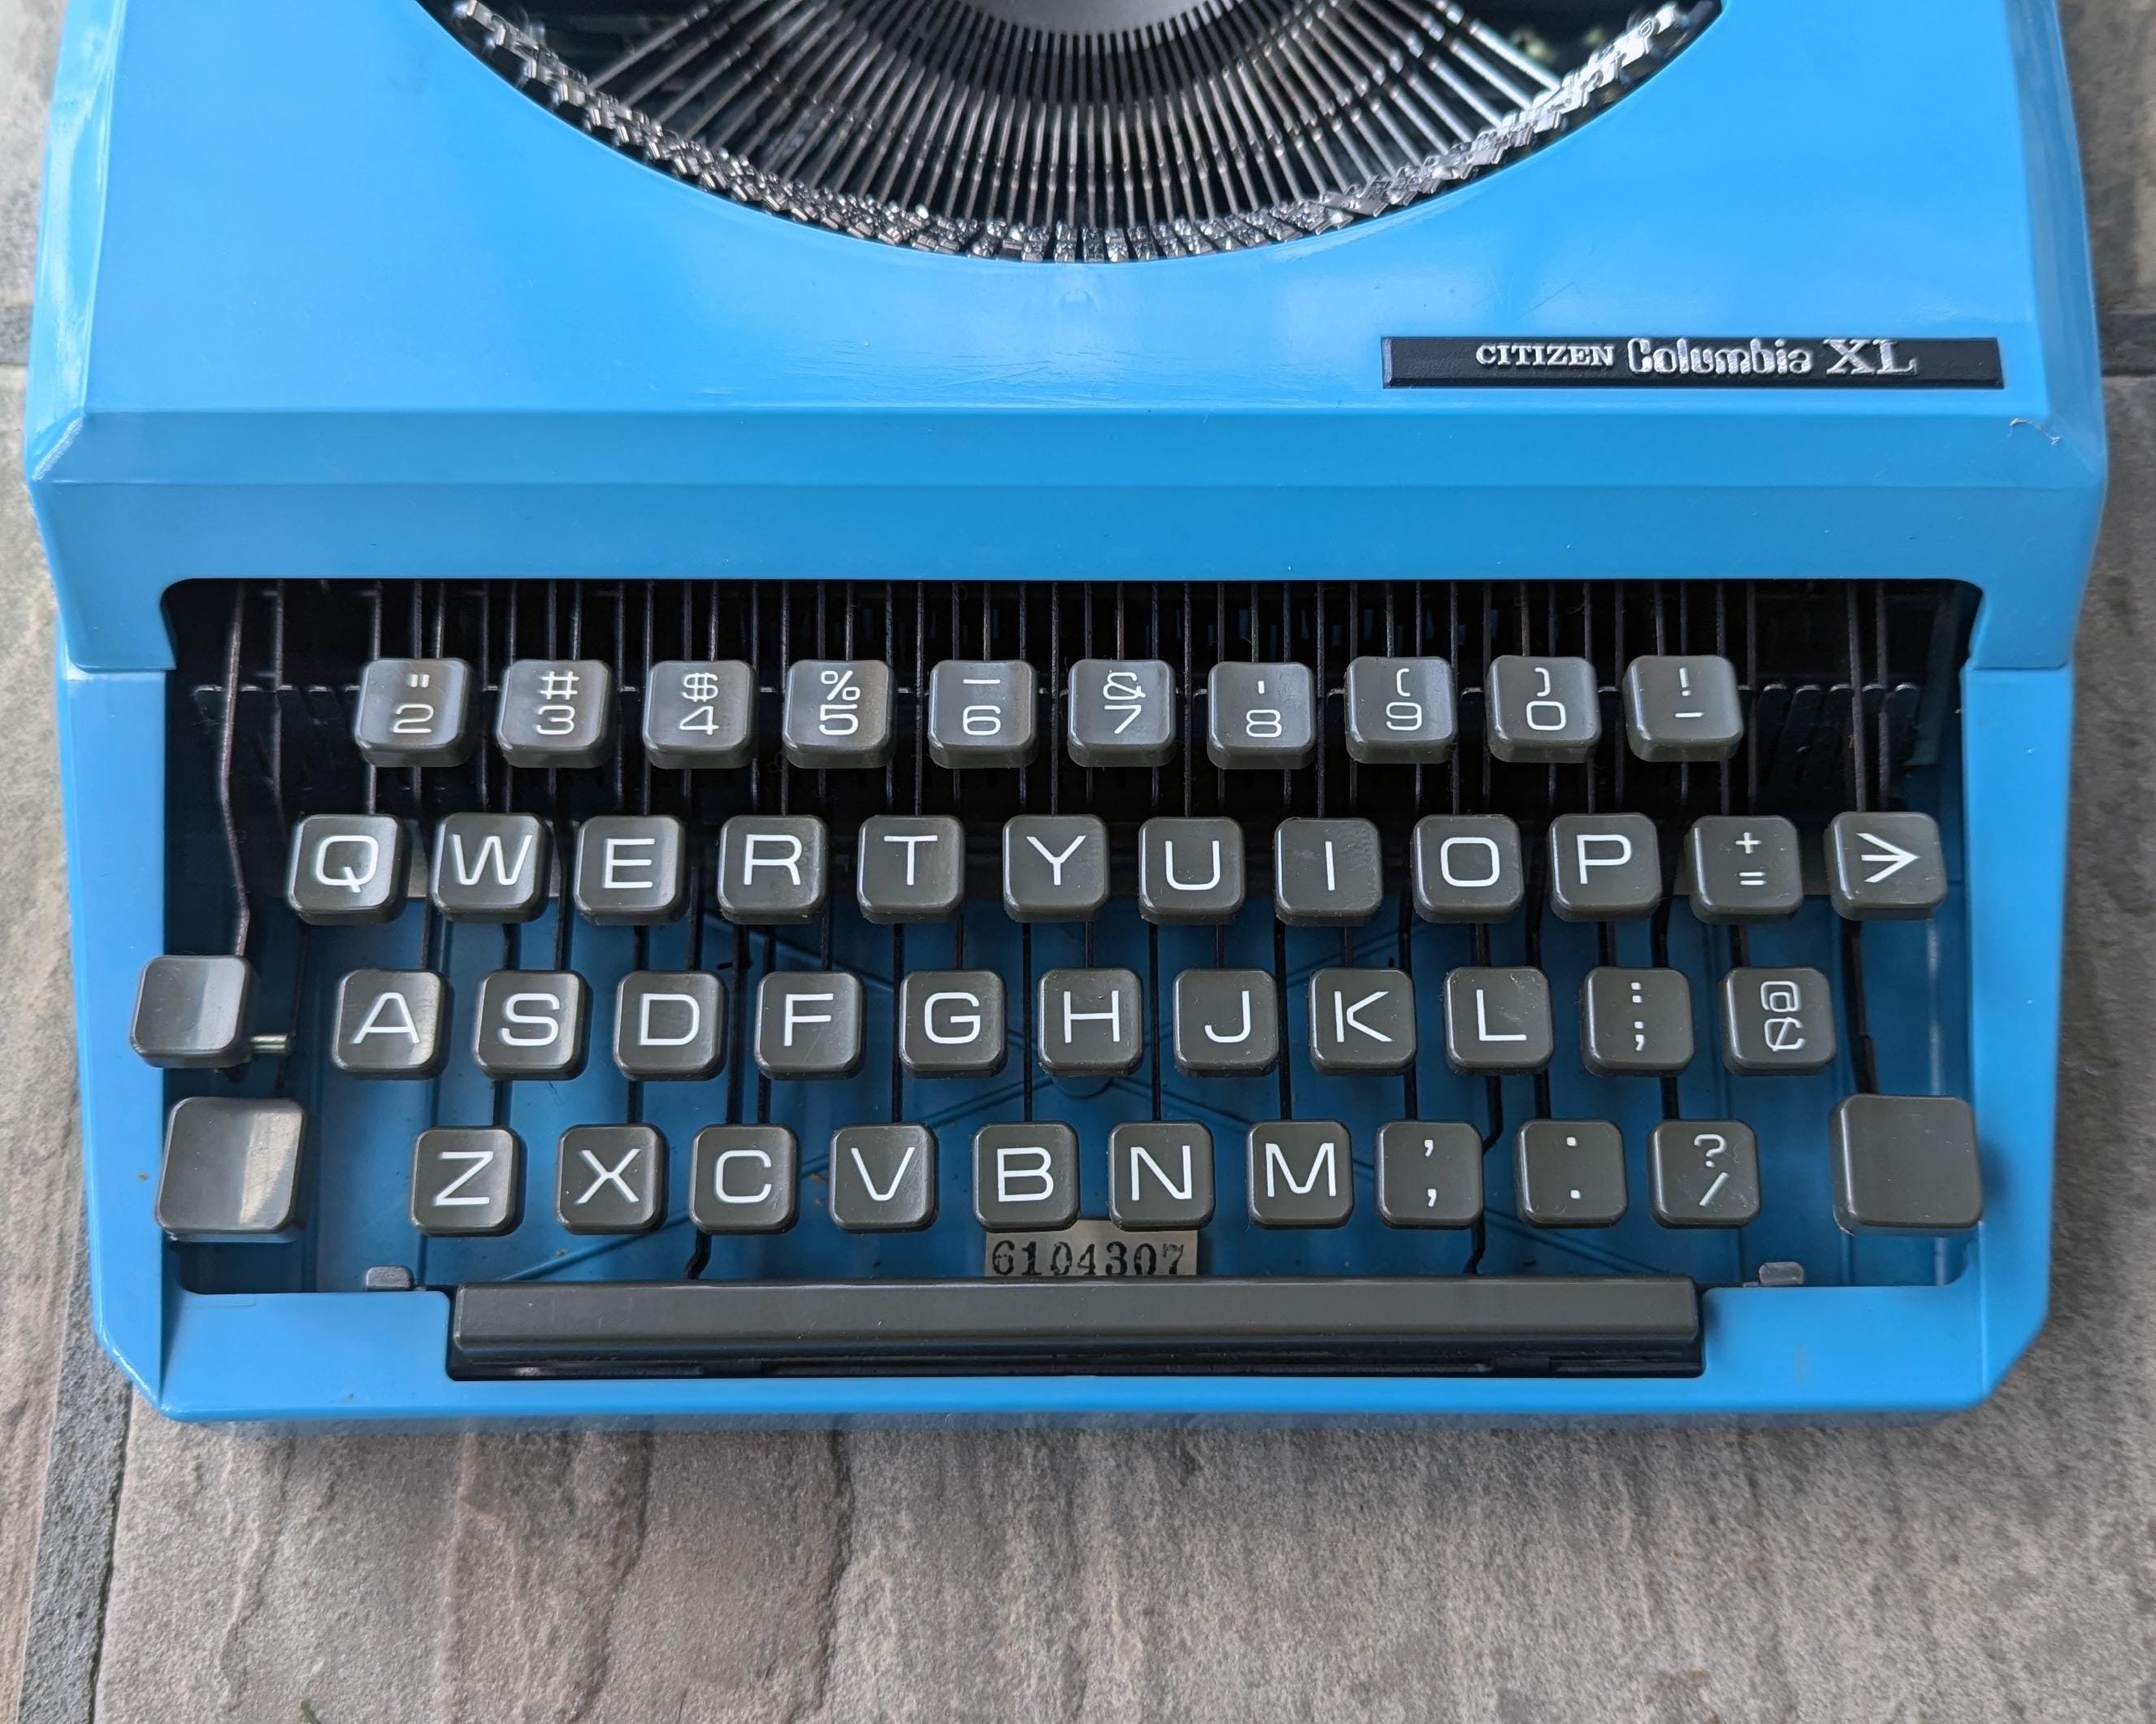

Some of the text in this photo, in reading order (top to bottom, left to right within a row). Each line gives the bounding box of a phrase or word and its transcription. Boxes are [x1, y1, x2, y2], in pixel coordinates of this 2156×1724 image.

[1475, 337, 1919, 375] CITIZEN Columbia XL
[540, 671, 579, 700] #
[682, 672, 718, 702] $
[820, 670, 860, 700] %
[1103, 671, 1146, 700] &
[1679, 668, 1691, 697] !
[392, 704, 434, 734] 2
[536, 705, 575, 734] 3
[679, 706, 718, 734] 4
[819, 704, 859, 735] 5
[962, 705, 1001, 735] 6
[1104, 704, 1142, 734] 7
[1246, 709, 1282, 738] 8
[1386, 702, 1423, 731] 9
[314, 835, 379, 893] Q
[452, 834, 532, 886] W
[603, 838, 655, 889] E
[744, 834, 802, 886] R
[884, 835, 938, 886] T
[1026, 835, 1087, 886] Y
[1165, 841, 1221, 891] U
[1325, 841, 1335, 891] I
[1441, 837, 1500, 887] O
[1577, 834, 1632, 885] P
[351, 993, 419, 1044] A
[500, 994, 562, 1046] S
[639, 994, 700, 1046] D
[783, 994, 834, 1046] F
[924, 992, 981, 1044] G
[1063, 990, 1120, 1043] H
[1204, 990, 1251, 1043] J
[1334, 991, 1392, 1042] K
[1476, 990, 1527, 1042] L
[1760, 981, 1800, 1012] @
[851, 1147, 915, 1202] V
[997, 1147, 1055, 1202] B
[1130, 1146, 1192, 1201] N
[1265, 1143, 1336, 1197] M
[1694, 1134, 1726, 1167] ?
[433, 1151, 493, 1206] Z
[576, 1149, 640, 1204] X
[715, 1150, 772, 1204] C
[991, 1240, 1184, 1276] 6104307
